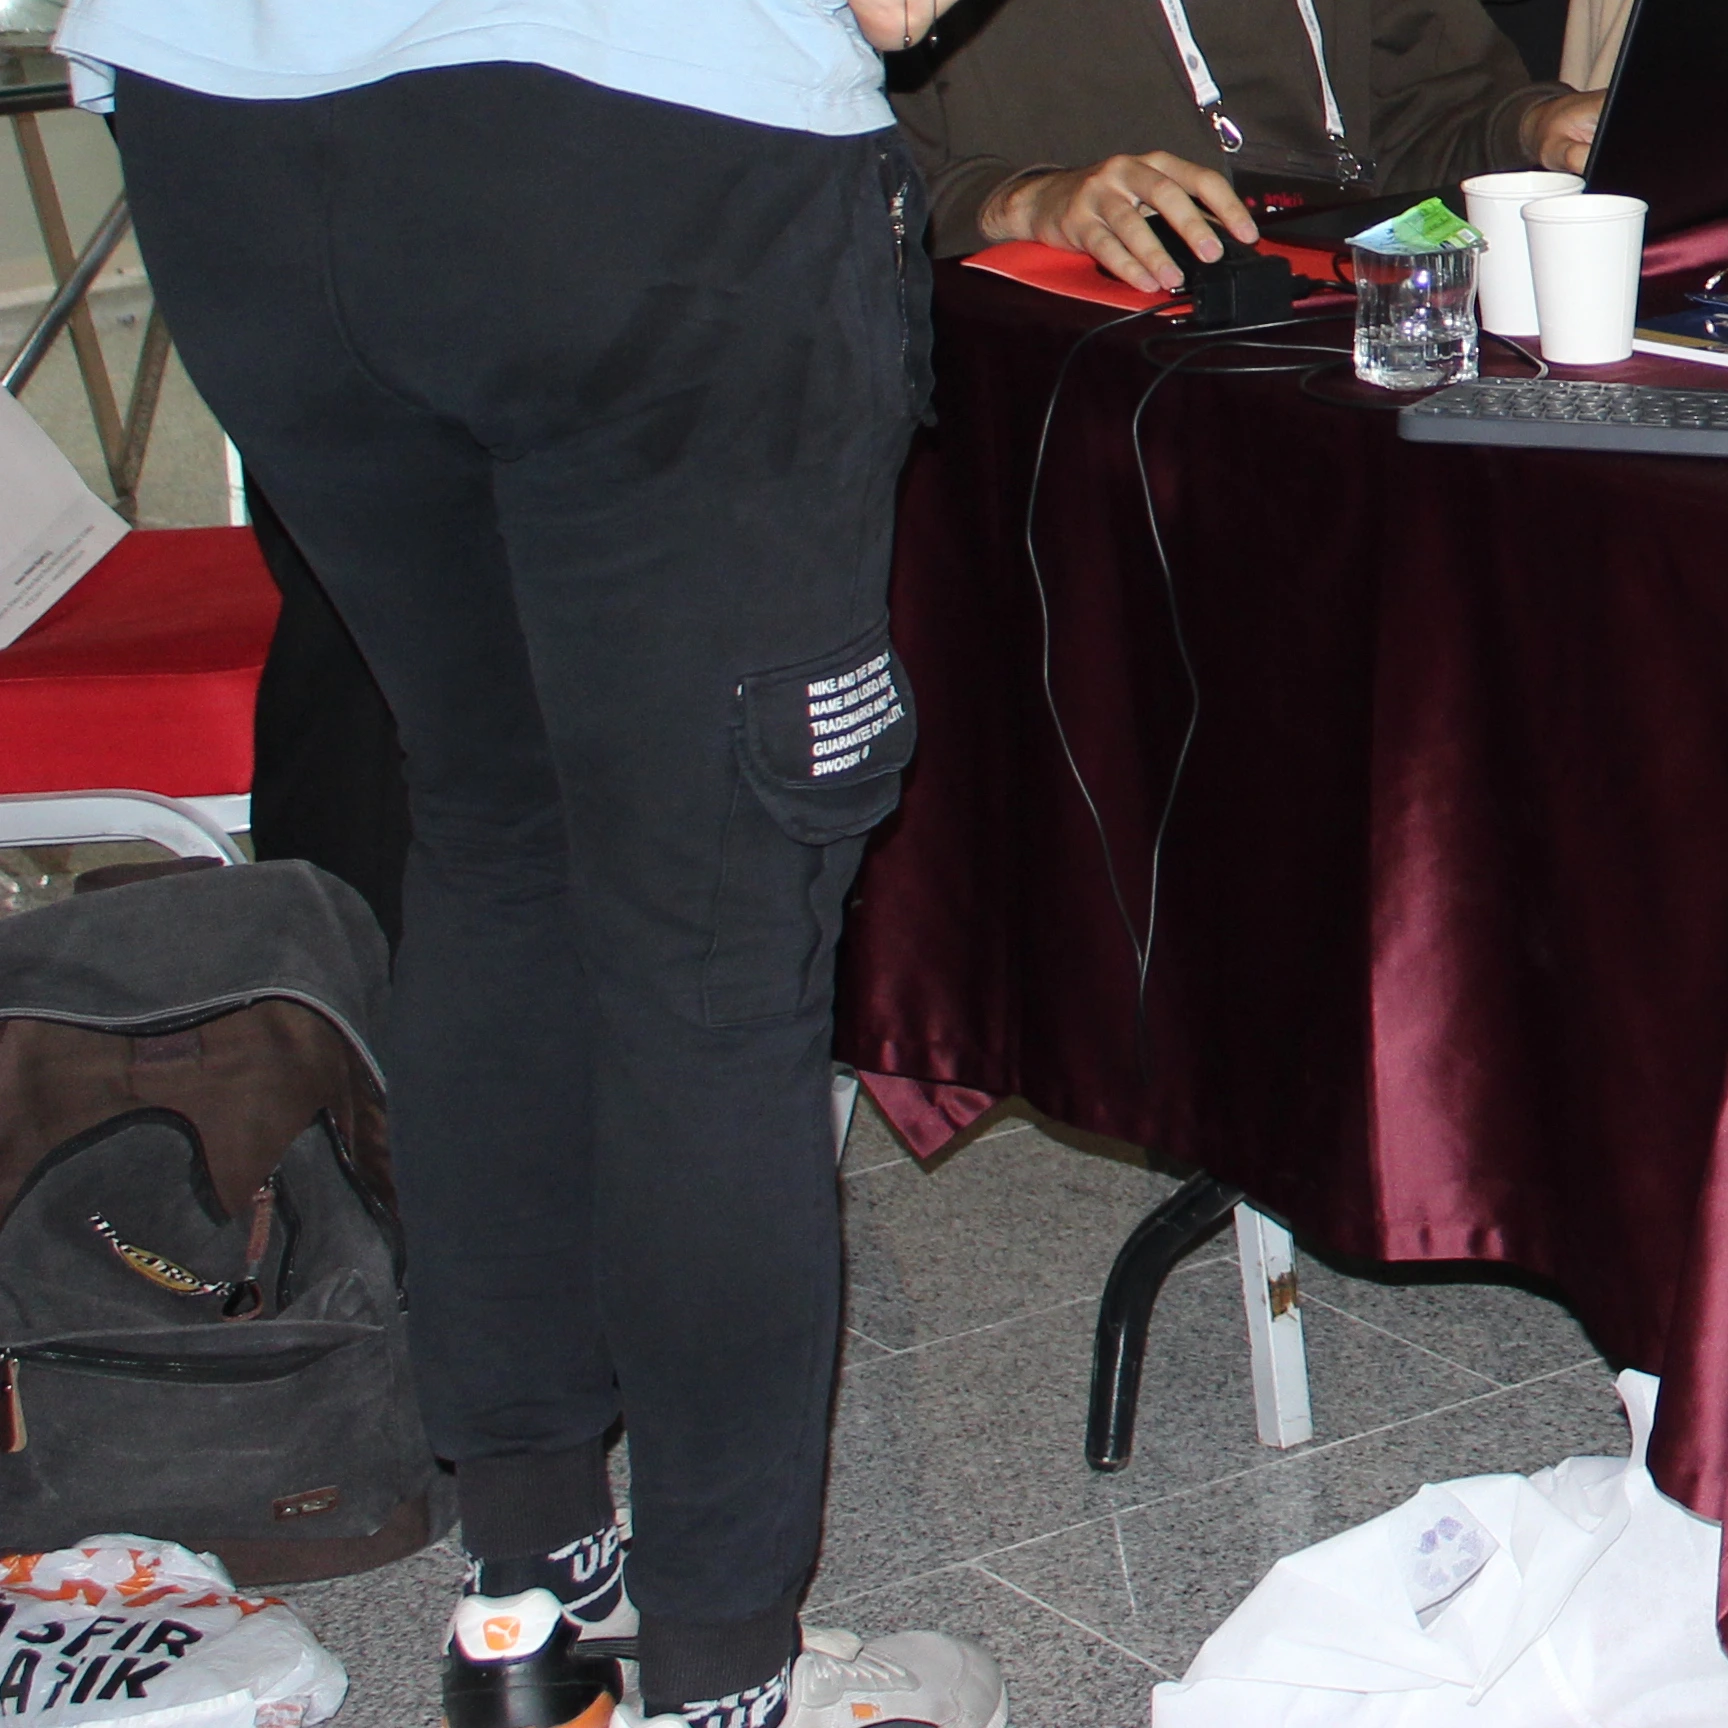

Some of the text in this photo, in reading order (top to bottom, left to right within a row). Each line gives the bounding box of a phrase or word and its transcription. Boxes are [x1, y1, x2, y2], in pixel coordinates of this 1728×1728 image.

[808, 678, 838, 697] NIKE
[808, 696, 843, 717] NAME
[810, 703, 873, 737] TRADEMARKS
[812, 724, 873, 757] GUARANTEE
[872, 718, 883, 736] OF
[812, 750, 861, 776] SWOOSH
[572, 1525, 621, 1584] UP
